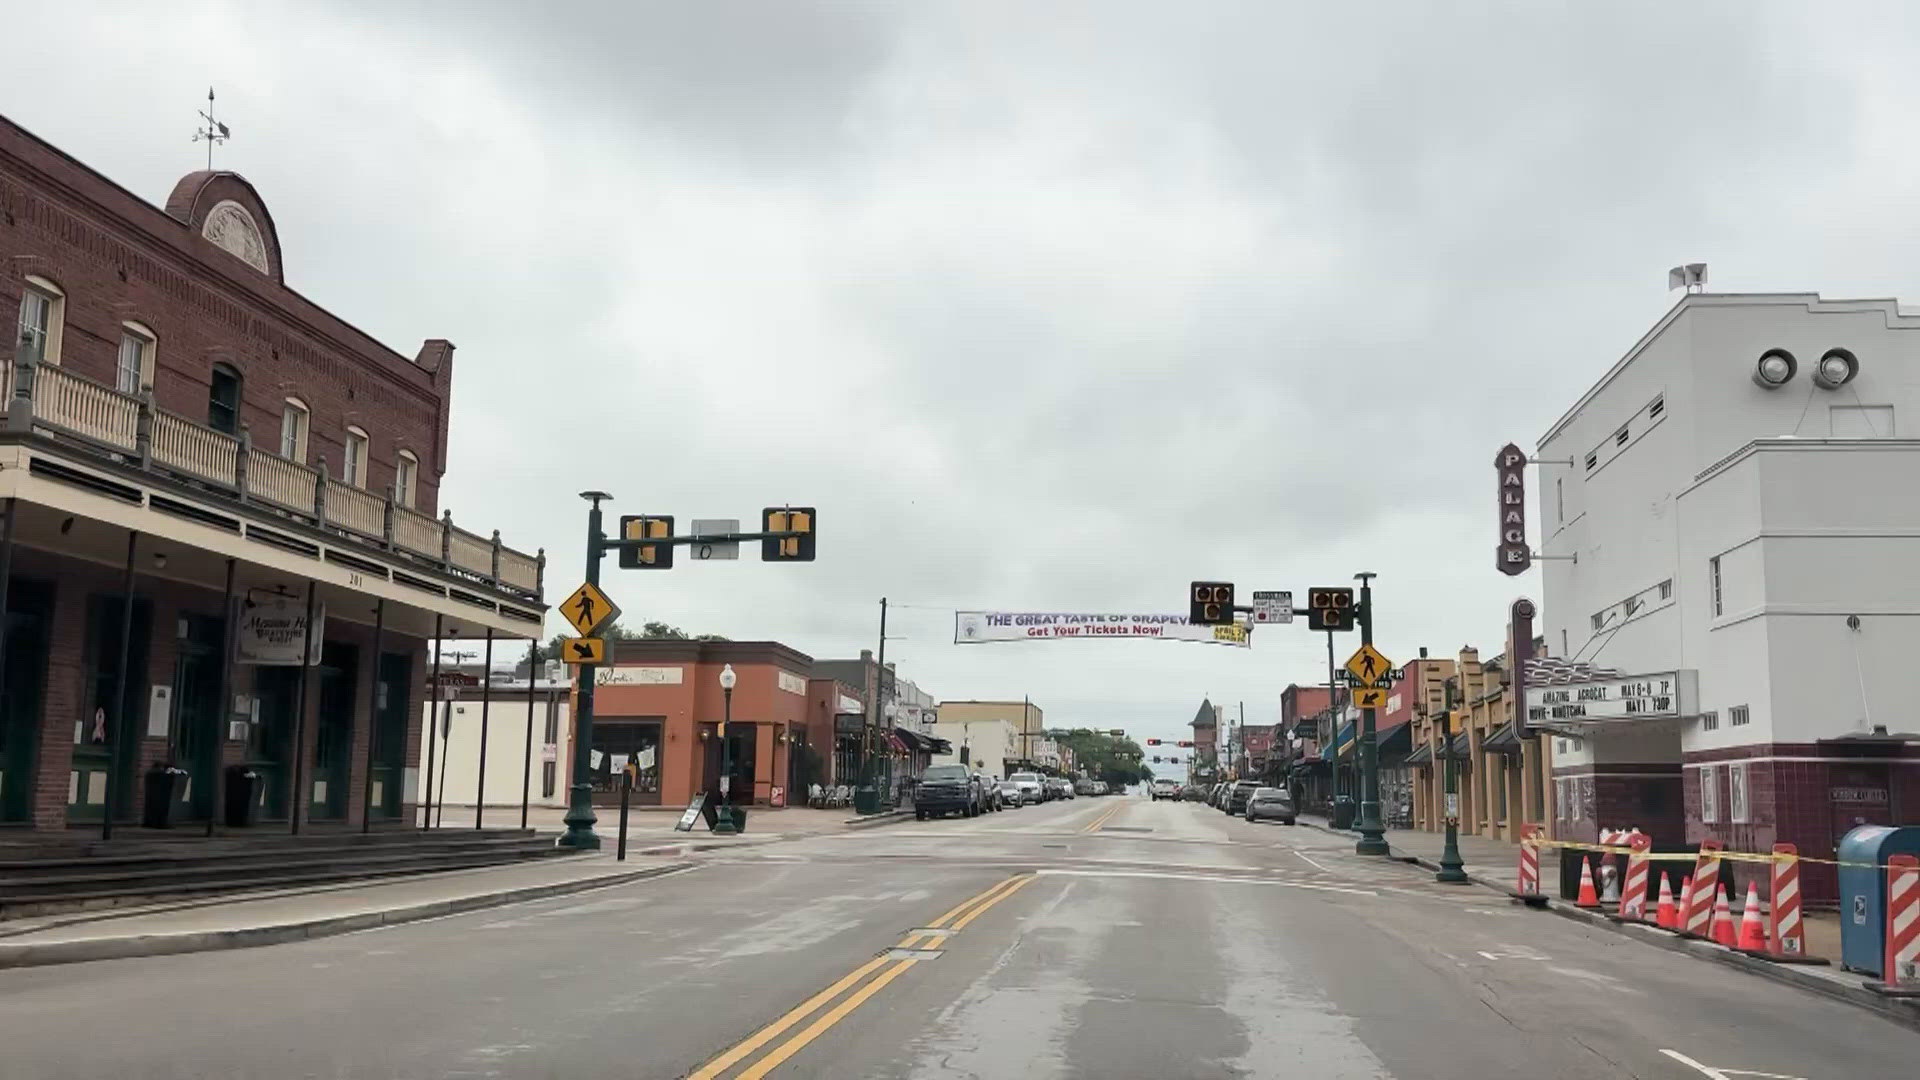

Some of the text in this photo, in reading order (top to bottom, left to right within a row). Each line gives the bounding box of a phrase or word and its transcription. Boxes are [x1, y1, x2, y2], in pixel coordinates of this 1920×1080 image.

[1505, 455, 1523, 562] PALACE
[985, 615, 1012, 626] THE
[1015, 614, 1058, 626] GREAT
[1062, 614, 1105, 624] TASTE
[1027, 625, 1164, 637] Get Your Tickets Now!
[1543, 690, 1570, 704] AMAZING
[1577, 686, 1607, 701] ACROCAT
[1621, 684, 1636, 697] MAY
[1660, 680, 1669, 694] 7P
[1626, 699, 1641, 712] MAY
[1652, 696, 1670, 711] 730P
